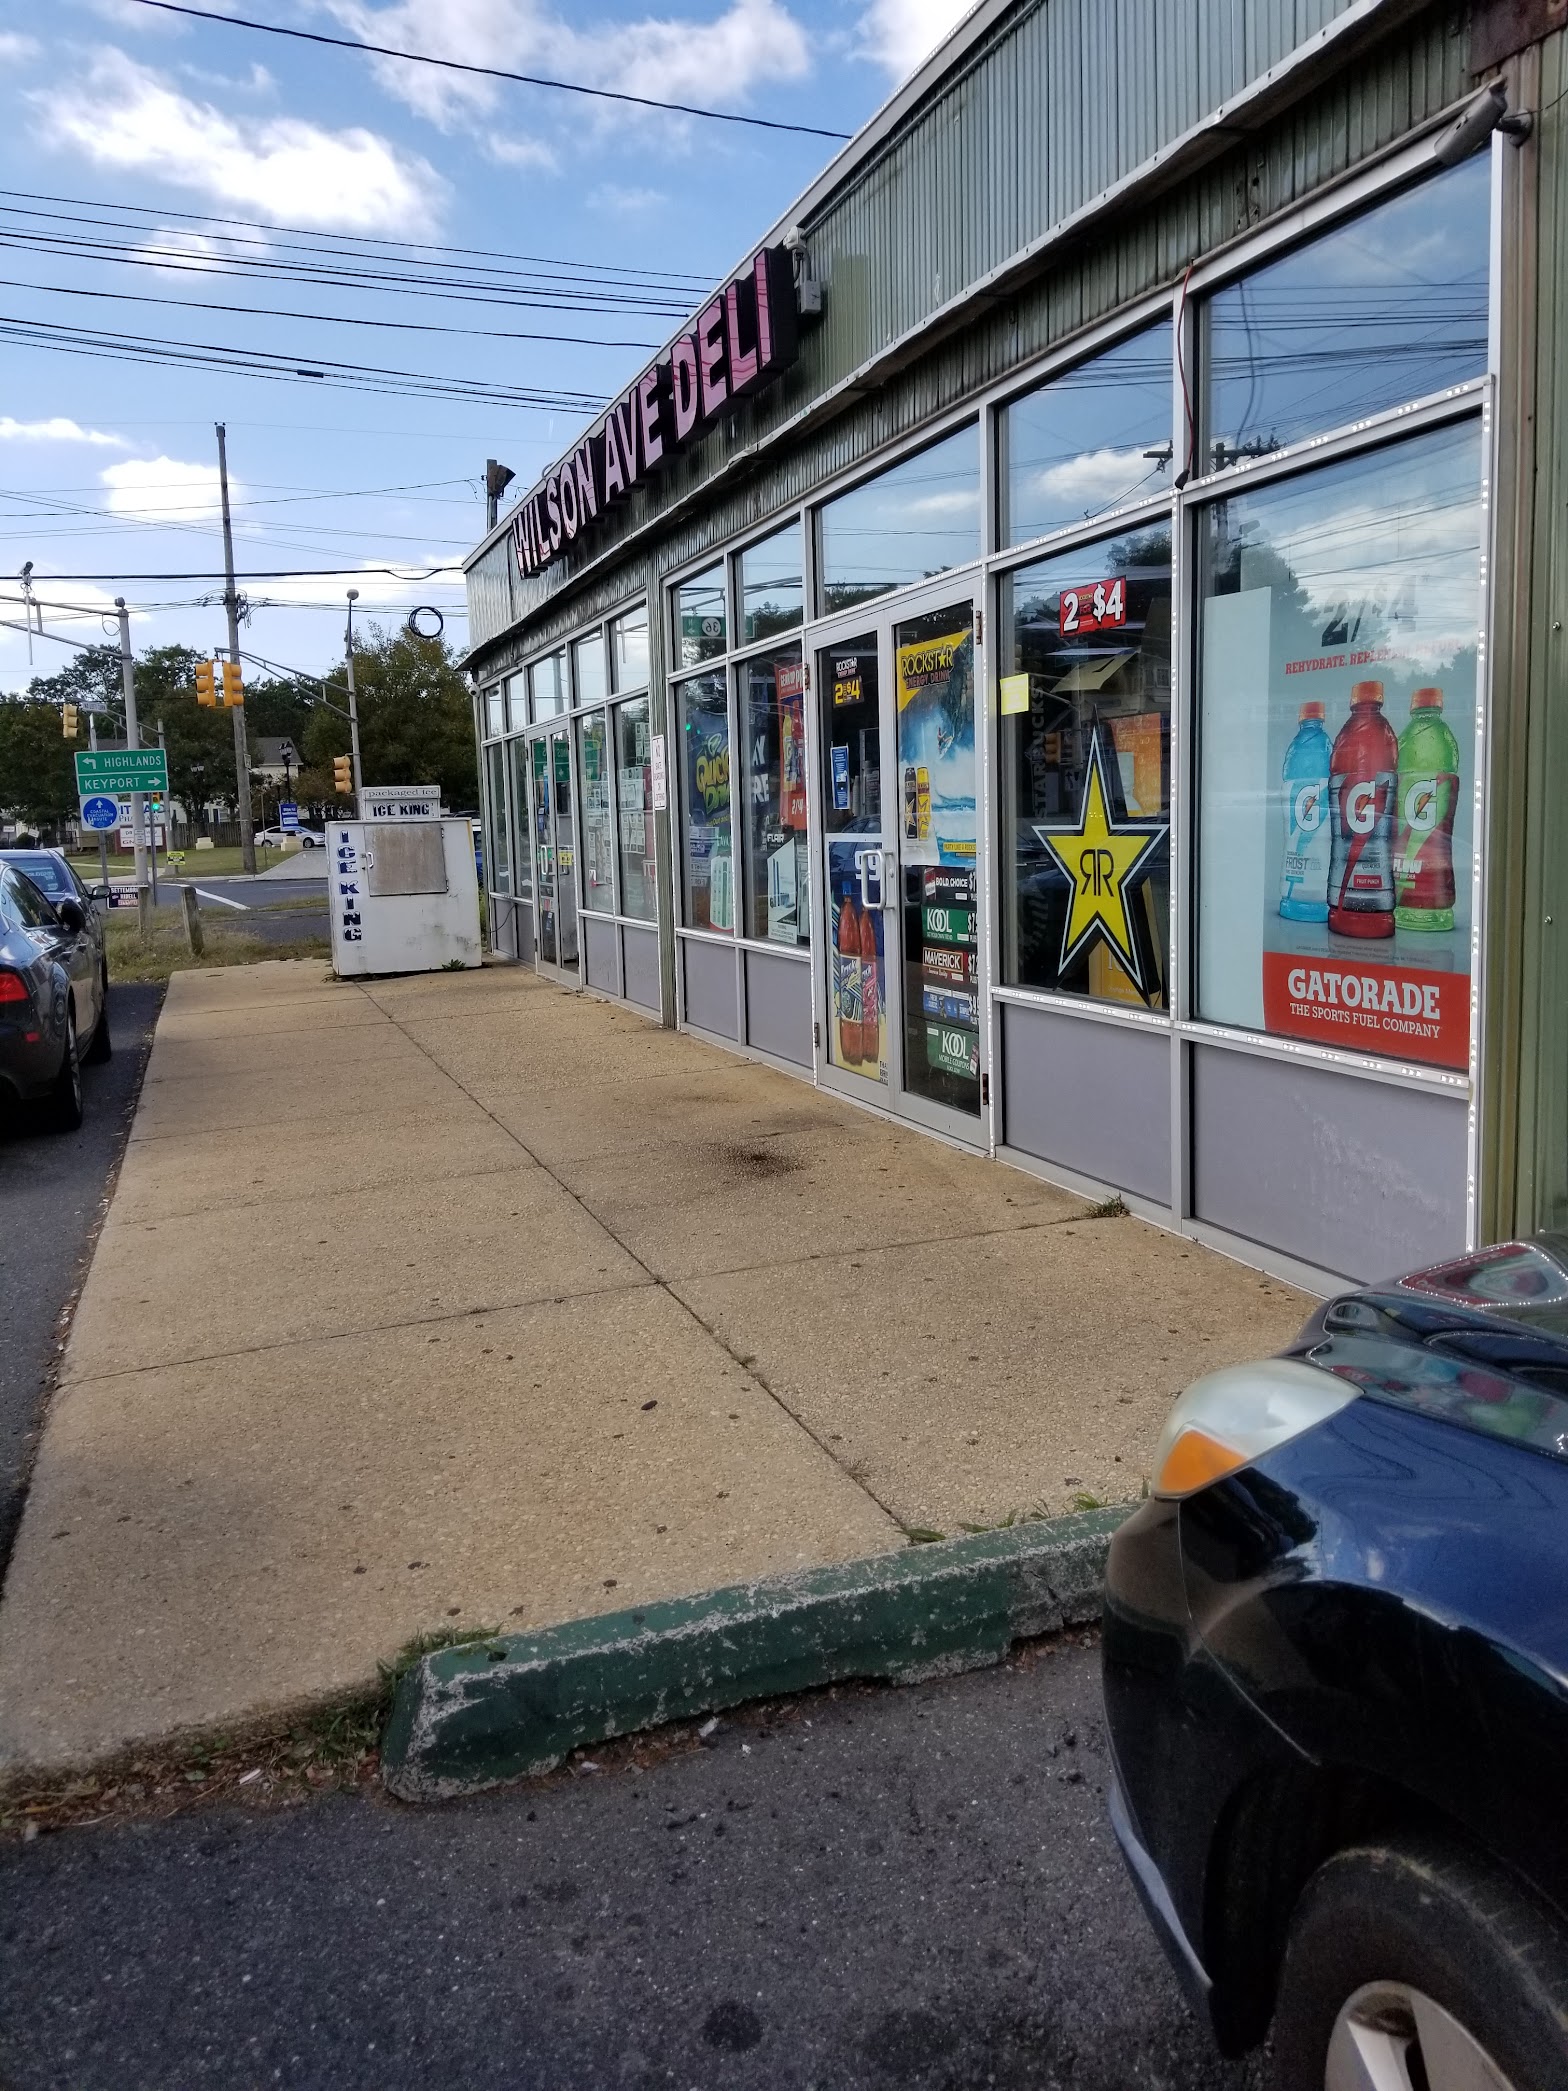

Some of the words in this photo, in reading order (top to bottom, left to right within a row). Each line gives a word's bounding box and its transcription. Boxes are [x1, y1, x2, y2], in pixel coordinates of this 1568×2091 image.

[512, 437, 599, 579] WILSON
[604, 363, 664, 506] AVE
[670, 247, 774, 443] DELI
[1063, 592, 1080, 631] 2
[1092, 580, 1124, 622] $4
[1286, 654, 1347, 674] REHYDRATE.
[835, 683, 843, 704] 2
[847, 680, 860, 700] $4
[104, 756, 161, 768] HIGHLANDS
[84, 777, 140, 790] KEYPORT
[368, 789, 419, 797] packaged
[373, 803, 395, 817] ICE
[400, 803, 430, 816] KING
[1295, 784, 1321, 832] G
[1346, 781, 1376, 834] G
[1404, 779, 1438, 831] G
[337, 830, 357, 874] ICE
[1285, 856, 1311, 871] FROST
[936, 877, 949, 887] BOLD
[950, 878, 968, 888] CHOICE
[339, 880, 362, 941] KING
[927, 908, 953, 933] KOOL
[924, 950, 961, 969] MAVERICK
[1288, 968, 1440, 1020] GATORADE
[1290, 1003, 1309, 1017] THE
[1312, 1006, 1350, 1024] SPORTS
[1352, 1012, 1380, 1029] FUEL
[1382, 1017, 1441, 1039] COMPANY
[942, 1030, 969, 1060] KOOL
[939, 1054, 952, 1065] MOBILE
